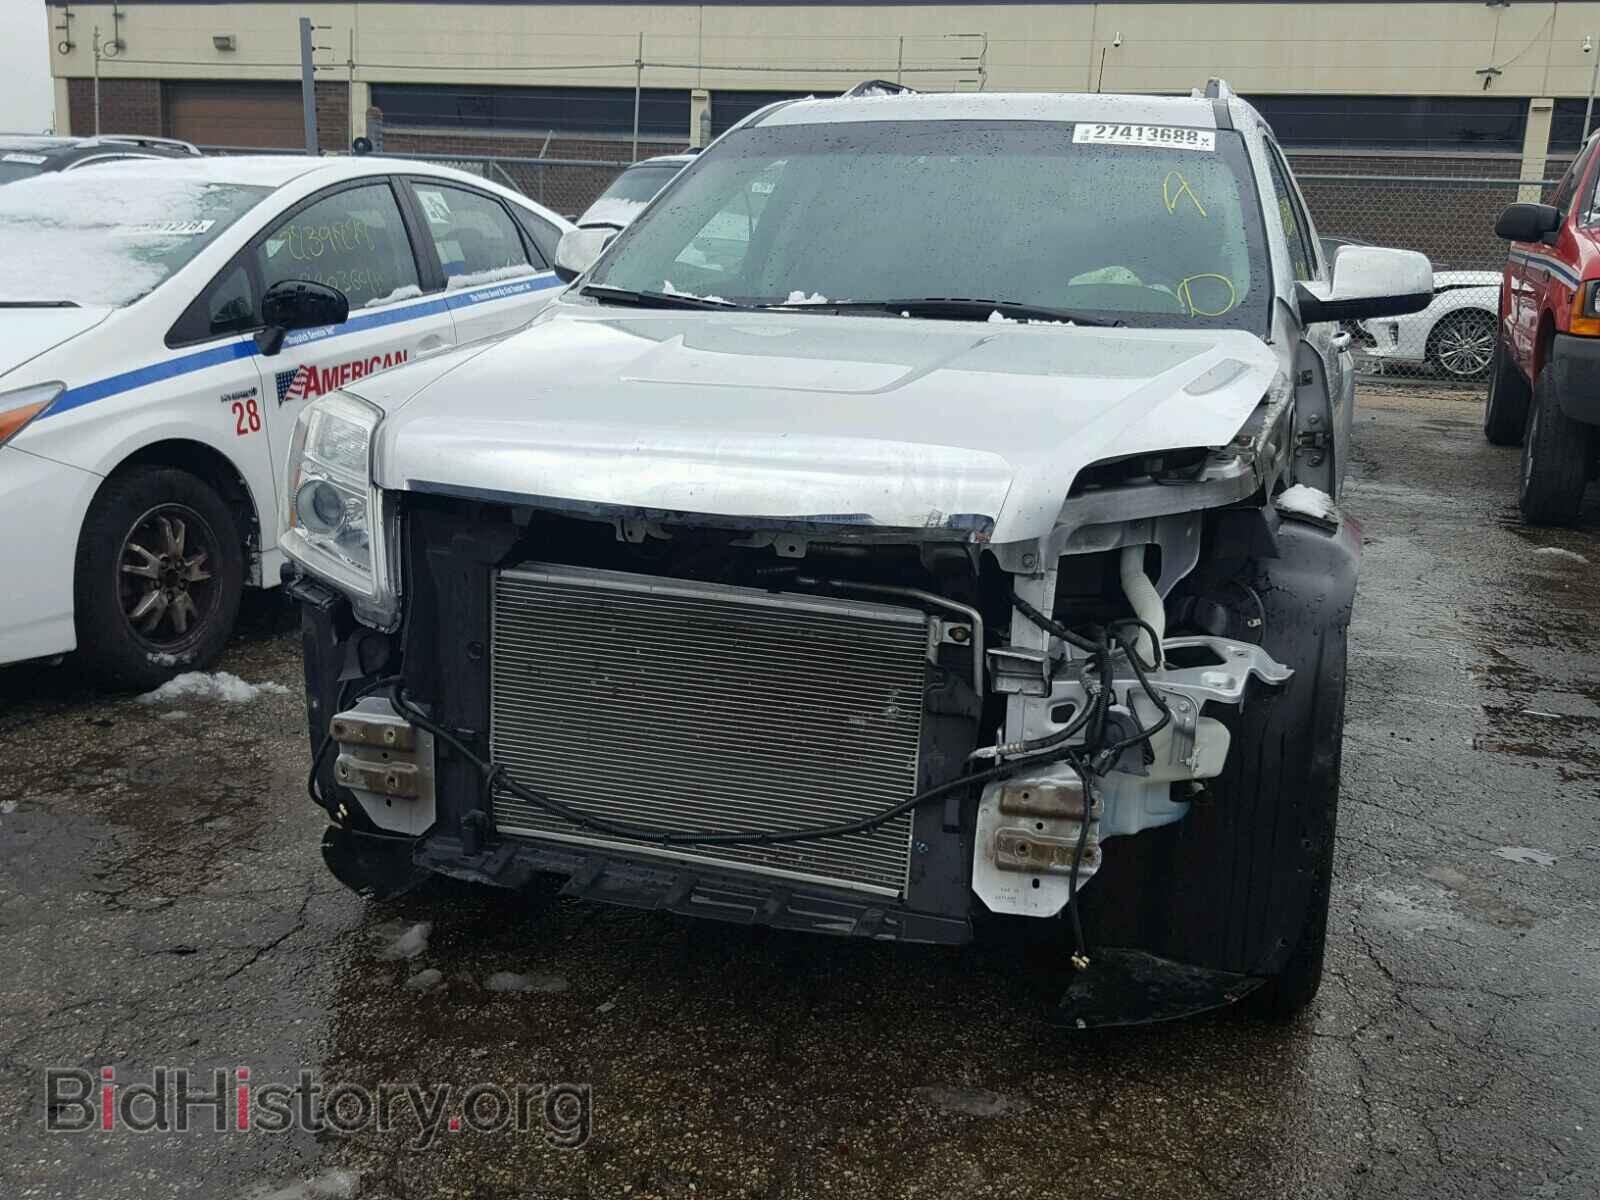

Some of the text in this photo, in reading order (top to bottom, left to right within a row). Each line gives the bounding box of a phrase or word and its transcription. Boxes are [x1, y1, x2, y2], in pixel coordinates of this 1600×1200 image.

[1093, 125, 1198, 145] 27413688
[1163, 170, 1208, 218] A
[232, 399, 261, 436] 28
